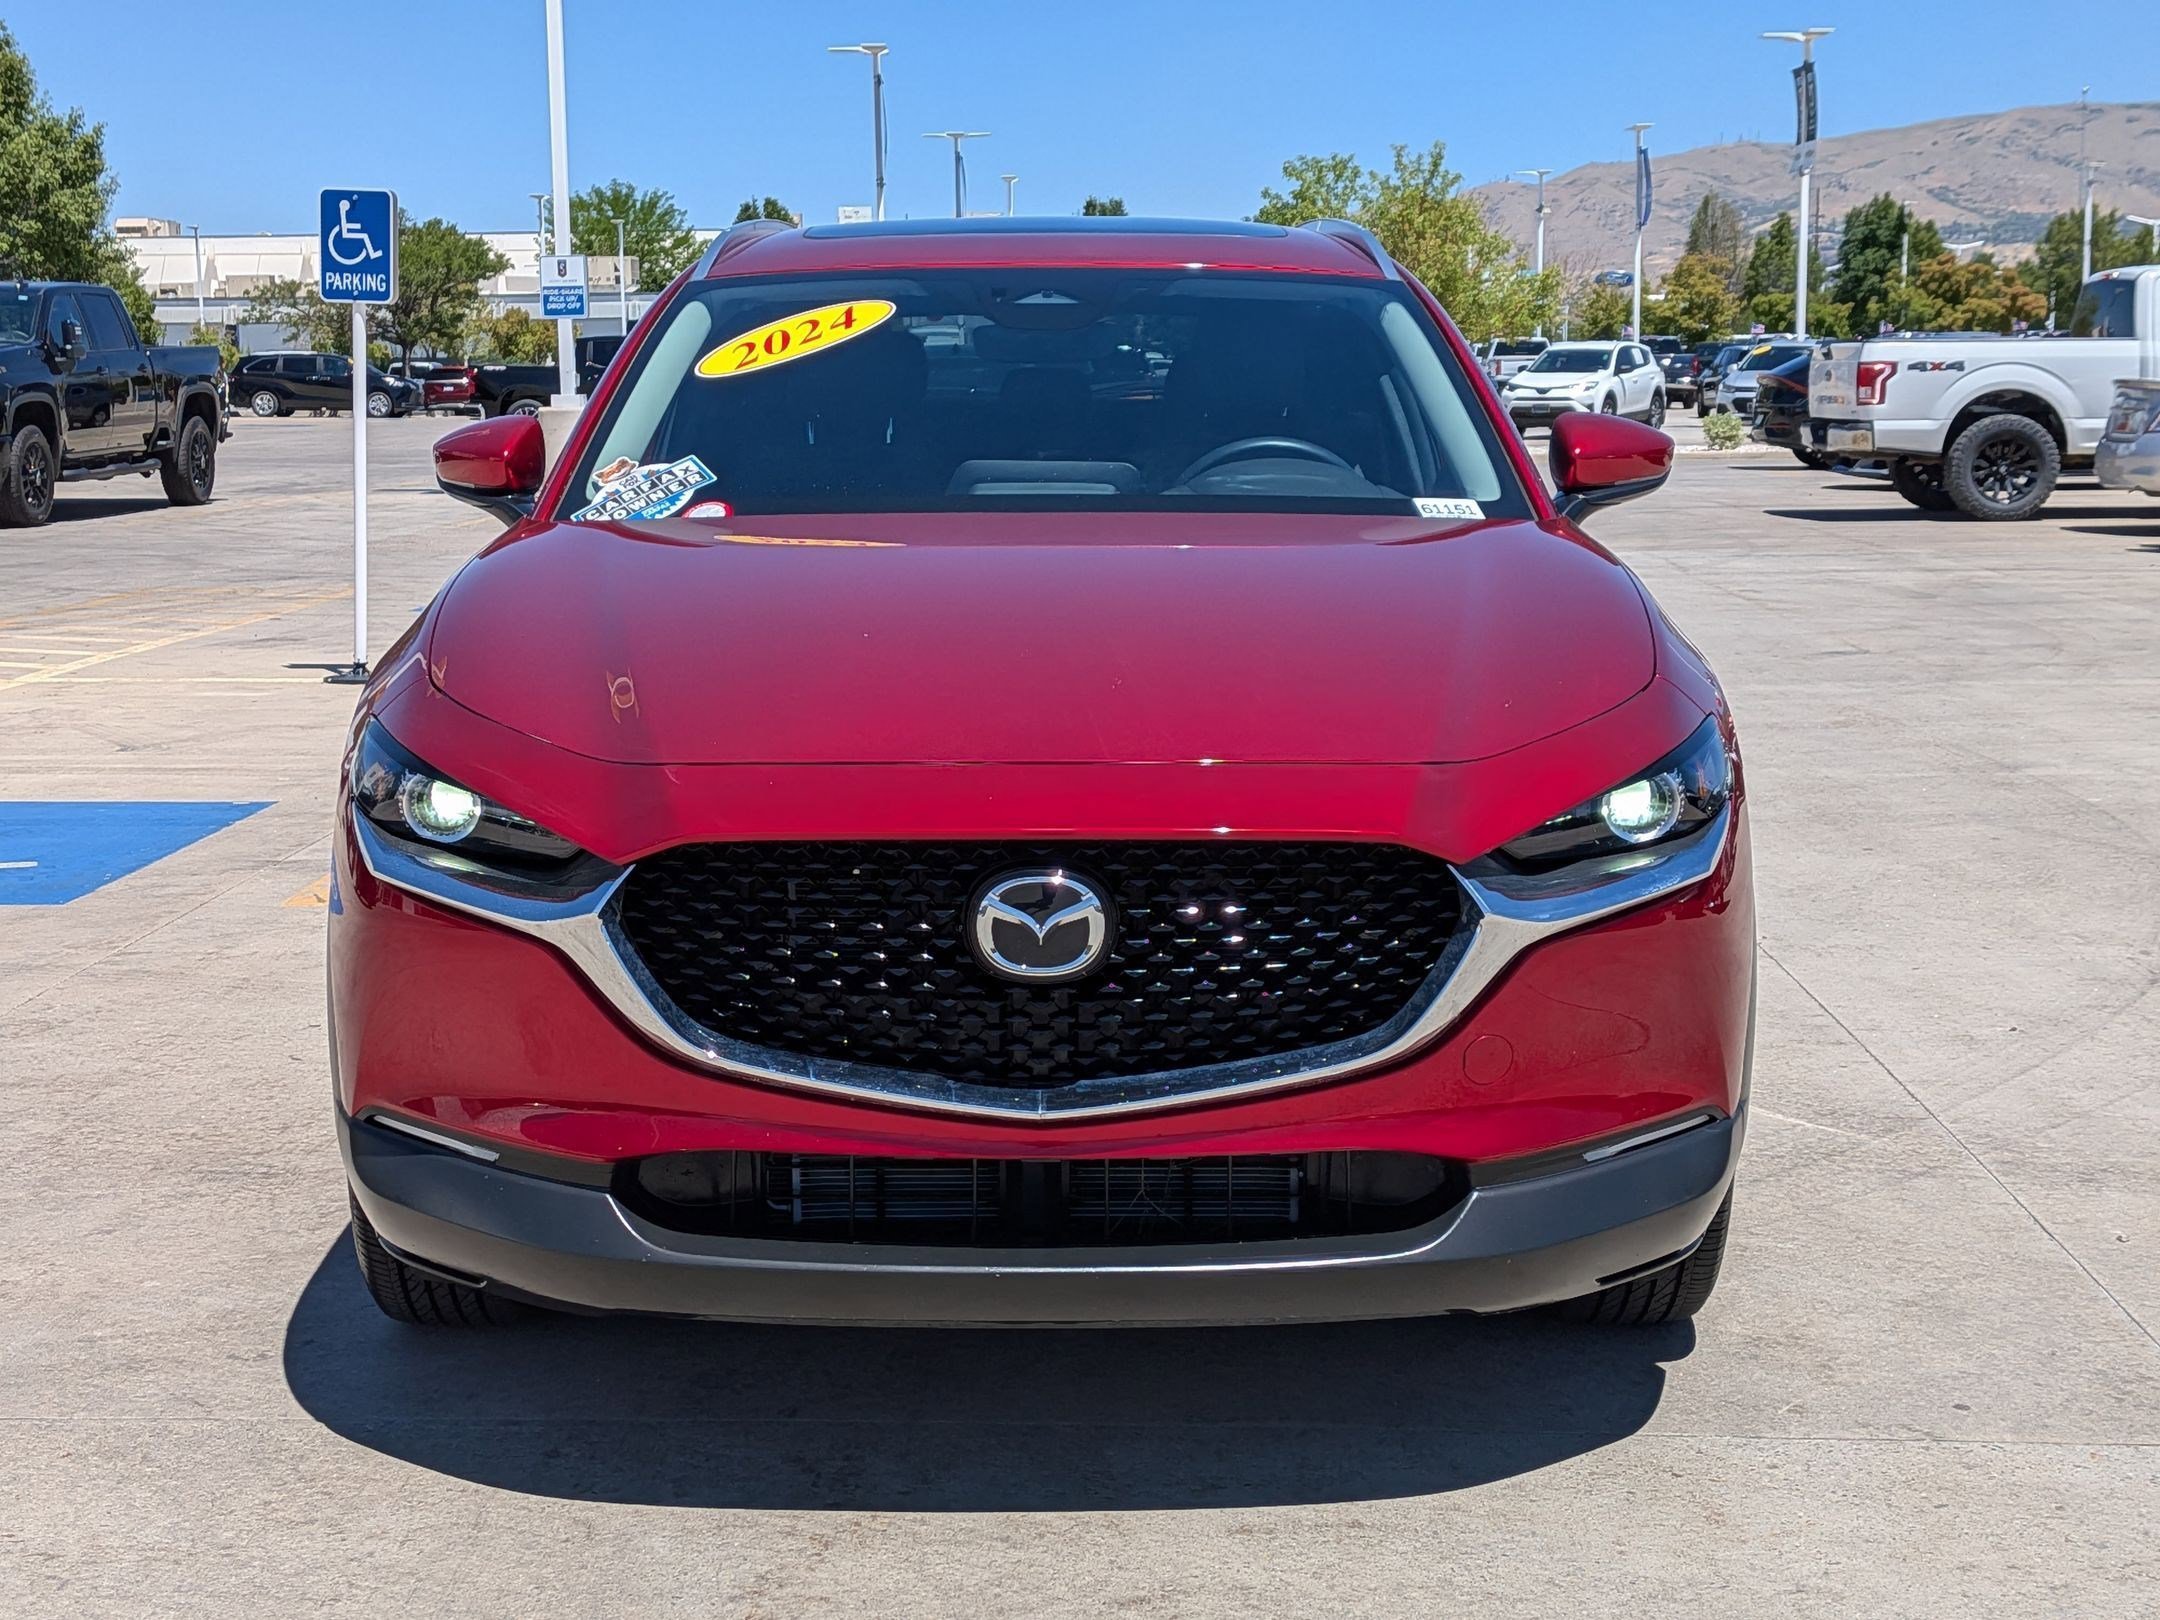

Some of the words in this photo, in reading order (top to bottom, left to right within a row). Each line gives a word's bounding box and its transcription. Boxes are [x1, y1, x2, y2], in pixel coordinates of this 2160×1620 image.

[325, 272, 387, 292] PARKING
[548, 295, 565, 303] PICK
[732, 306, 857, 370] 2024
[586, 466, 693, 520] CARFAX
[612, 471, 703, 519] OWNER
[1421, 503, 1477, 516] 61151
